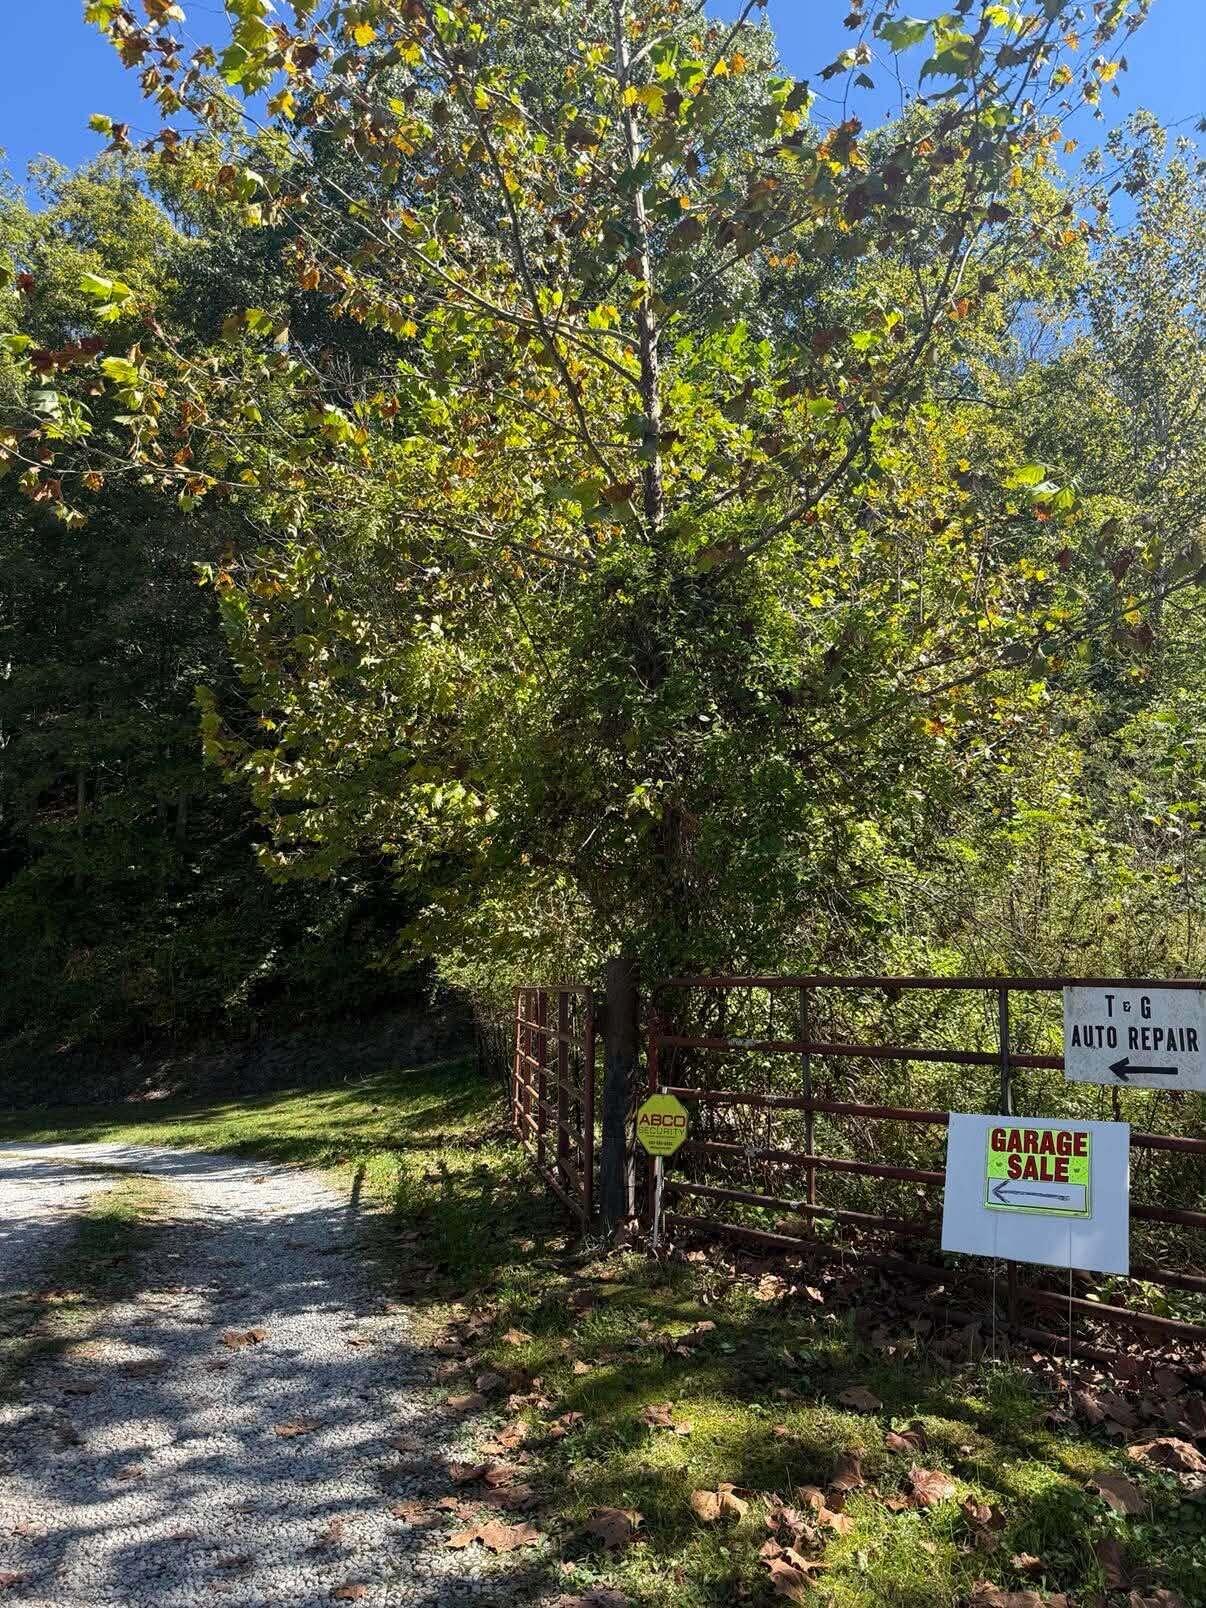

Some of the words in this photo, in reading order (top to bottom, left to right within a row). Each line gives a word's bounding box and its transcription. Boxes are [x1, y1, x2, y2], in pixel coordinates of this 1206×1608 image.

[1105, 995, 1115, 1017] T
[1123, 1001, 1131, 1012] &
[1141, 996, 1151, 1019] G
[1071, 1025, 1118, 1049] AUTO
[1128, 1026, 1199, 1052] REPAIR
[640, 1113, 686, 1127] ABCO
[640, 1127, 685, 1135] SECURITY
[991, 1128, 1088, 1157] GARAGE
[1007, 1153, 1070, 1183] SALE
